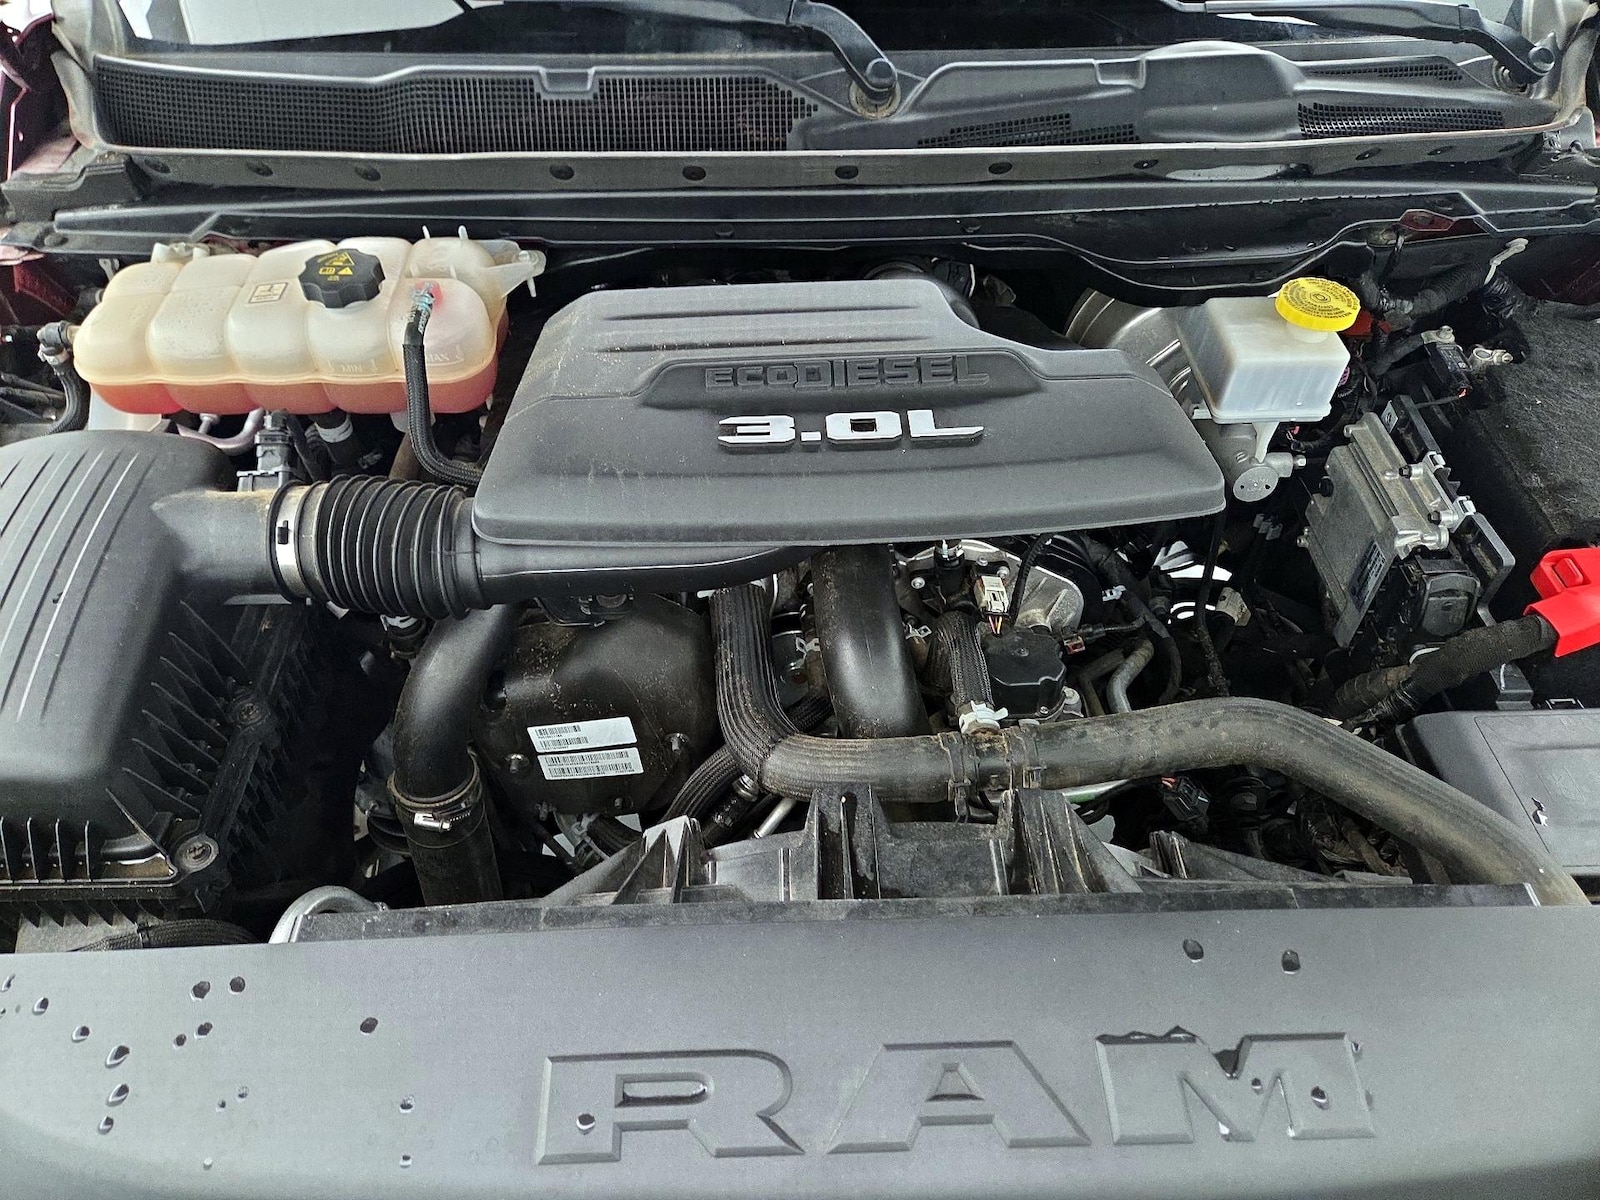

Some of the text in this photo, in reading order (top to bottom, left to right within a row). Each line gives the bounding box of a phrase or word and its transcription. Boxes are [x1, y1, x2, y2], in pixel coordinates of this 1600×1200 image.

[705, 354, 990, 391] ECODIESEL
[717, 409, 985, 447] 3.0L
[534, 1029, 1376, 1165] RAM
